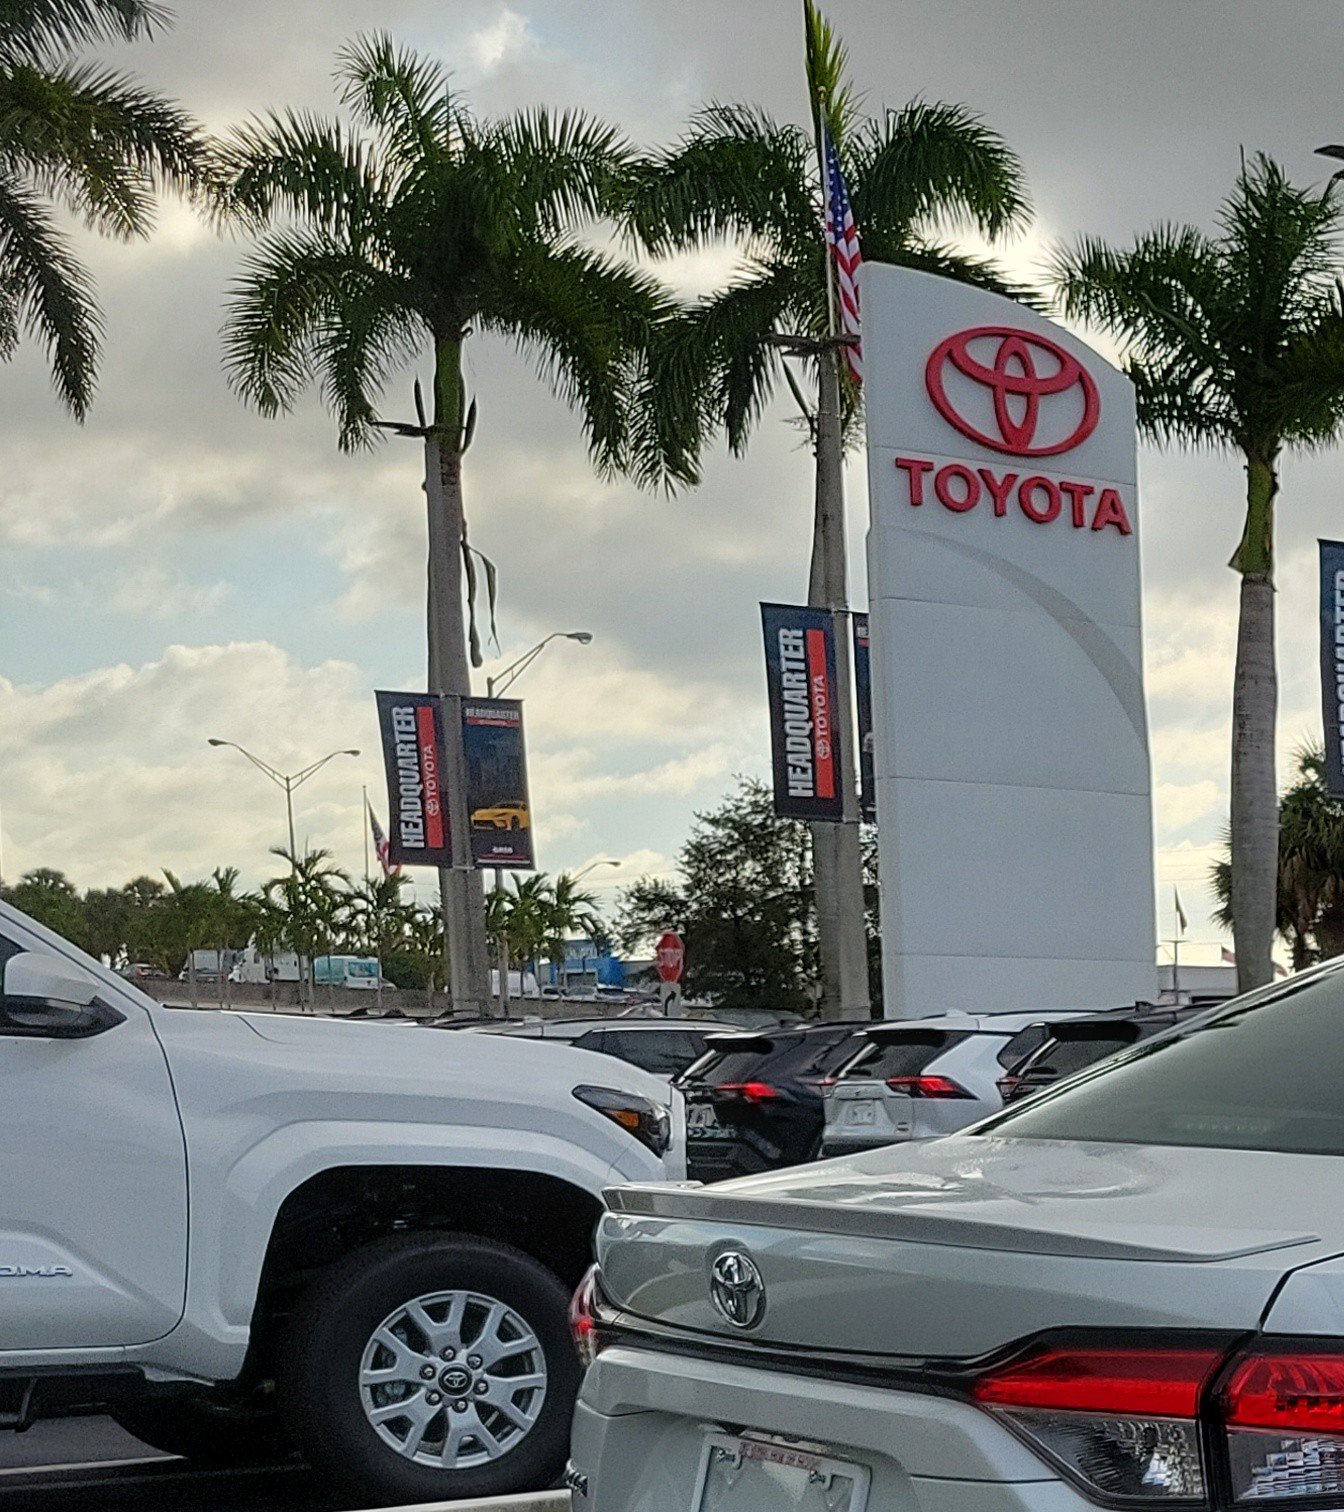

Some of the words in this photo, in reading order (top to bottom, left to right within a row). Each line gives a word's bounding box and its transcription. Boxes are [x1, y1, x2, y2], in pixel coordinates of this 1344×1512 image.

[895, 457, 1132, 535] TOYOTA
[778, 627, 814, 798] HEADQUARTER
[812, 675, 829, 736] TOYOTA
[392, 705, 425, 849] HEADQUARTER
[423, 745, 438, 798] TOYOTA
[659, 948, 682, 967] STOP
